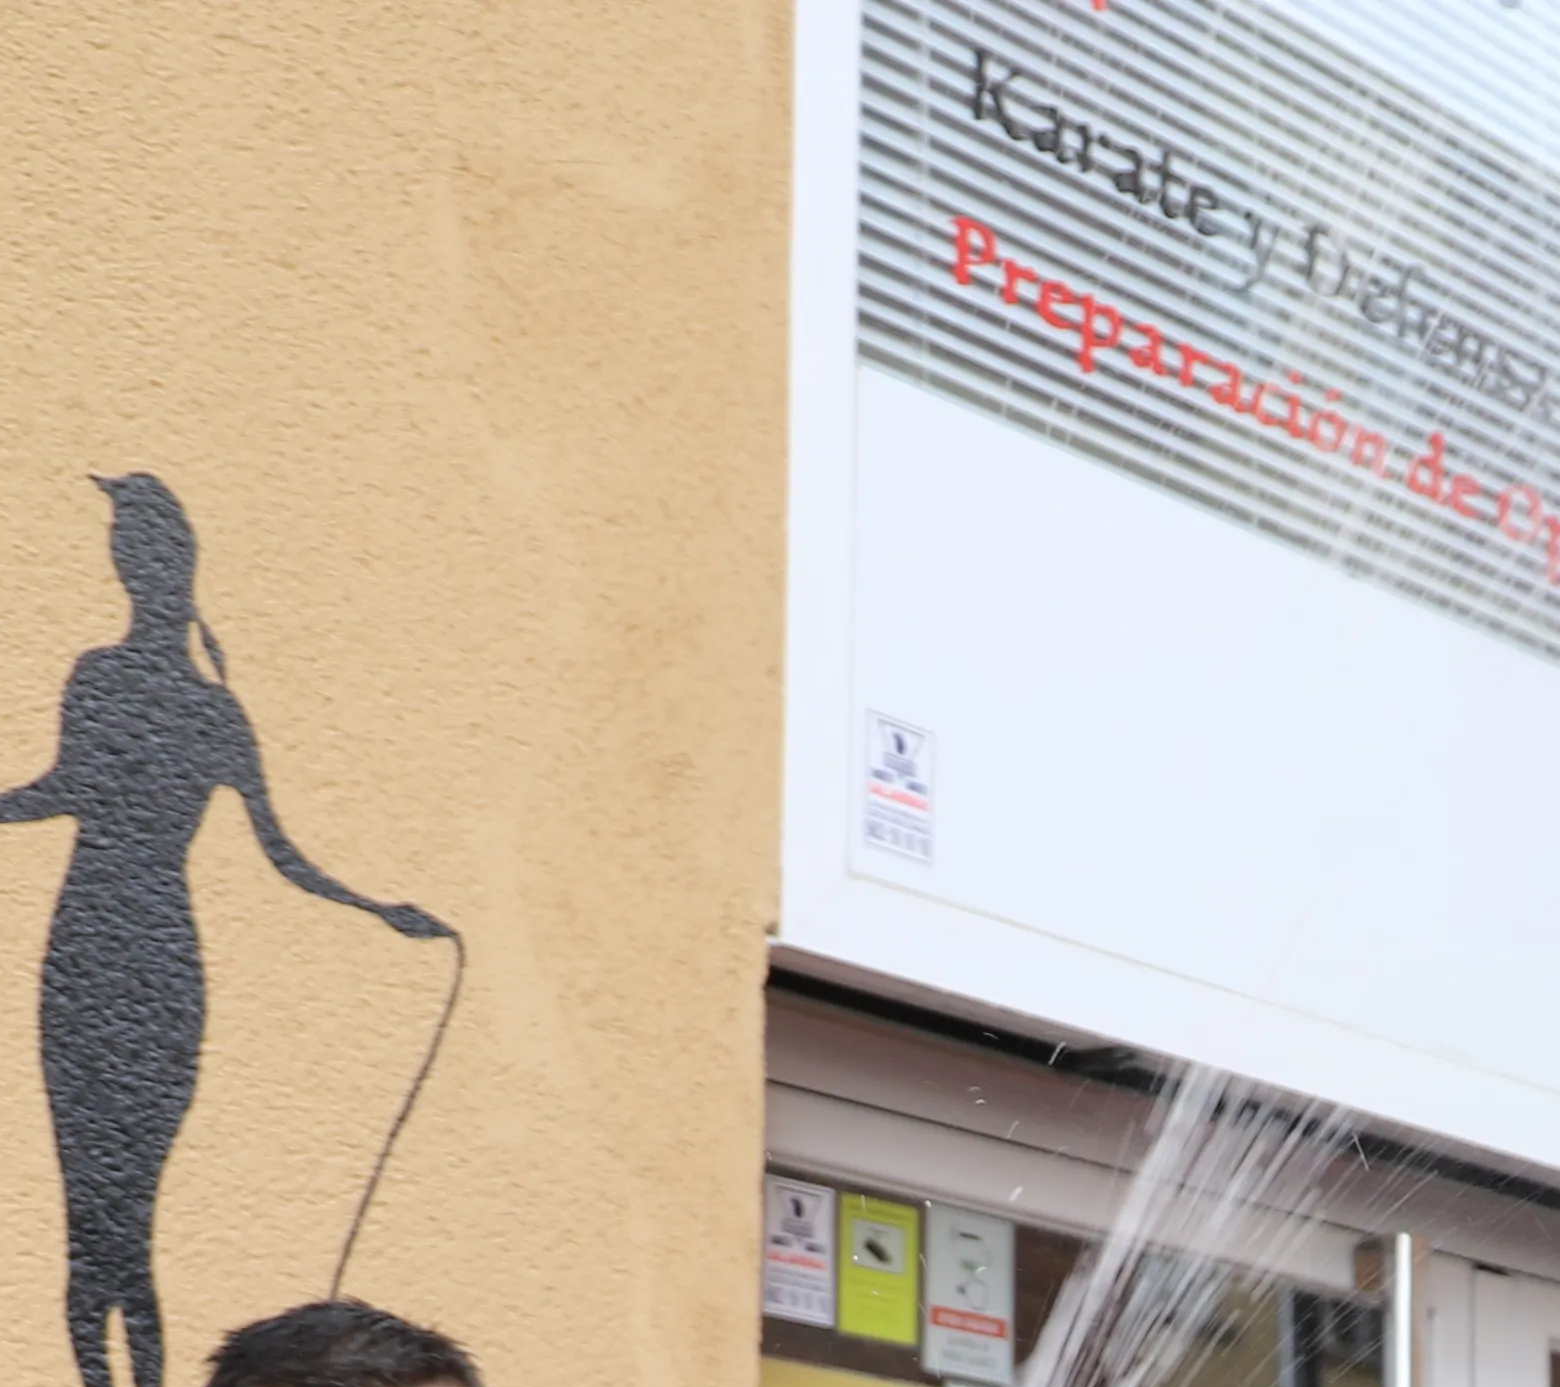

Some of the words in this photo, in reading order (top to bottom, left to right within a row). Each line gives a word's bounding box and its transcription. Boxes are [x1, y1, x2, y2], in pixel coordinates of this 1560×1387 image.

[972, 49, 1220, 236] Karate
[950, 214, 1392, 482] Preparación
[1405, 433, 1482, 520] de
